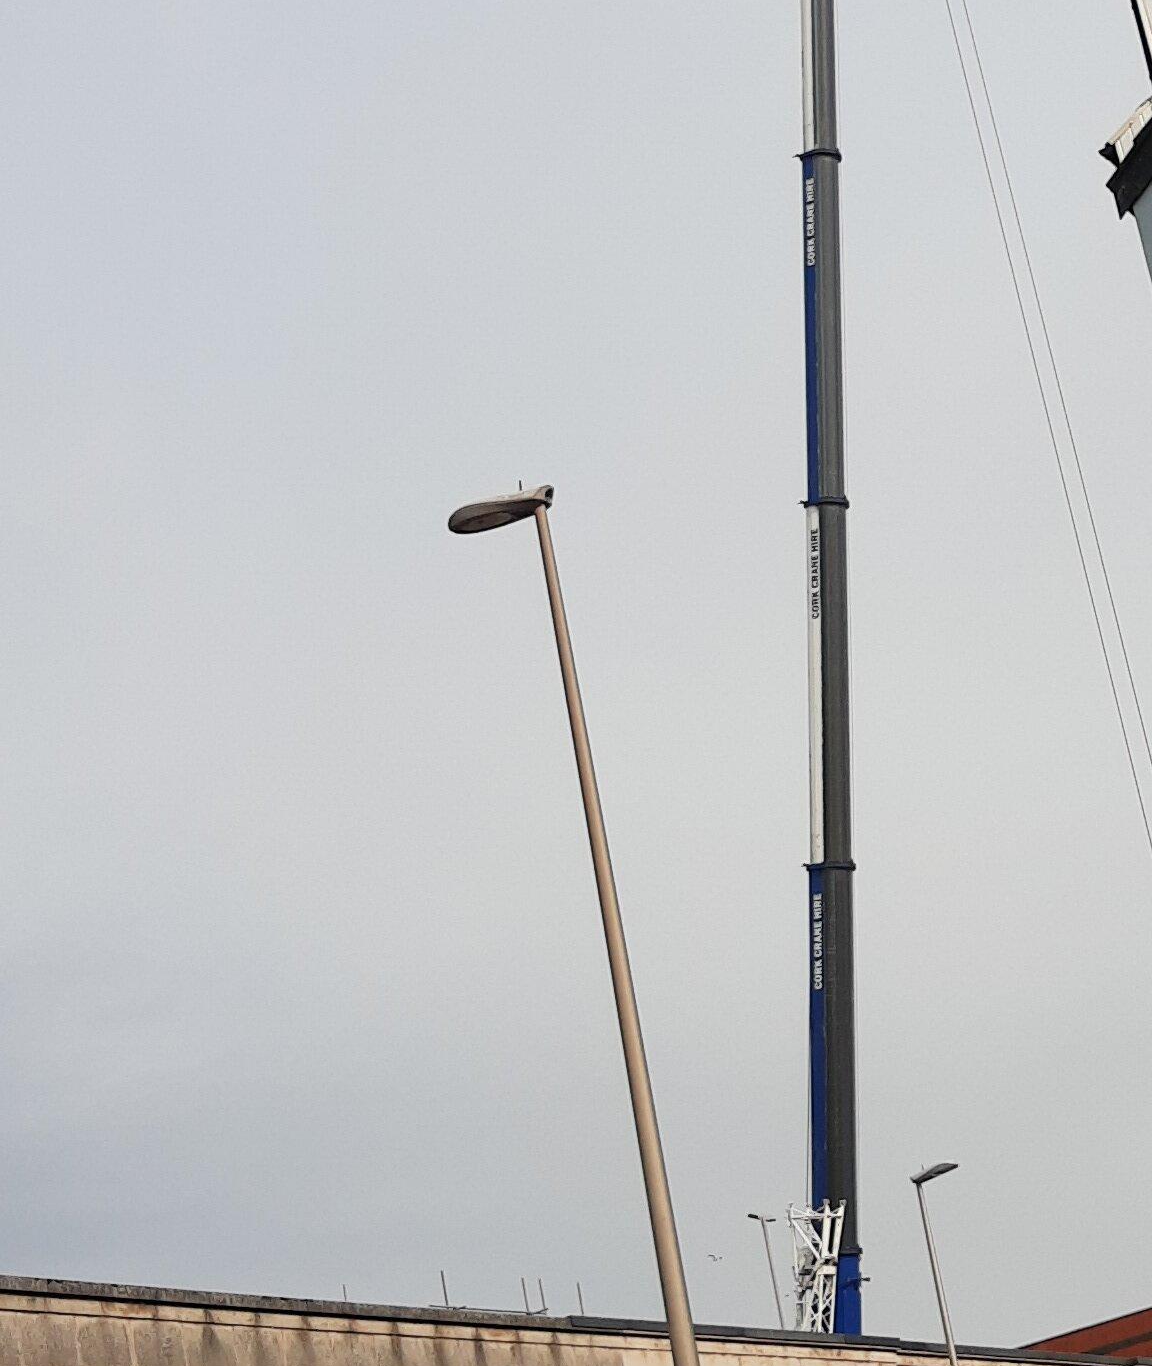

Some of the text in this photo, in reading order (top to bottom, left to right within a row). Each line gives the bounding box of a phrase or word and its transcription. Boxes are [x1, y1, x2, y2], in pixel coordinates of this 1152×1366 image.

[811, 528, 820, 553] HIRE
[811, 555, 820, 588] CRANE
[814, 921, 823, 957] CRANE
[814, 960, 823, 989] CORK
